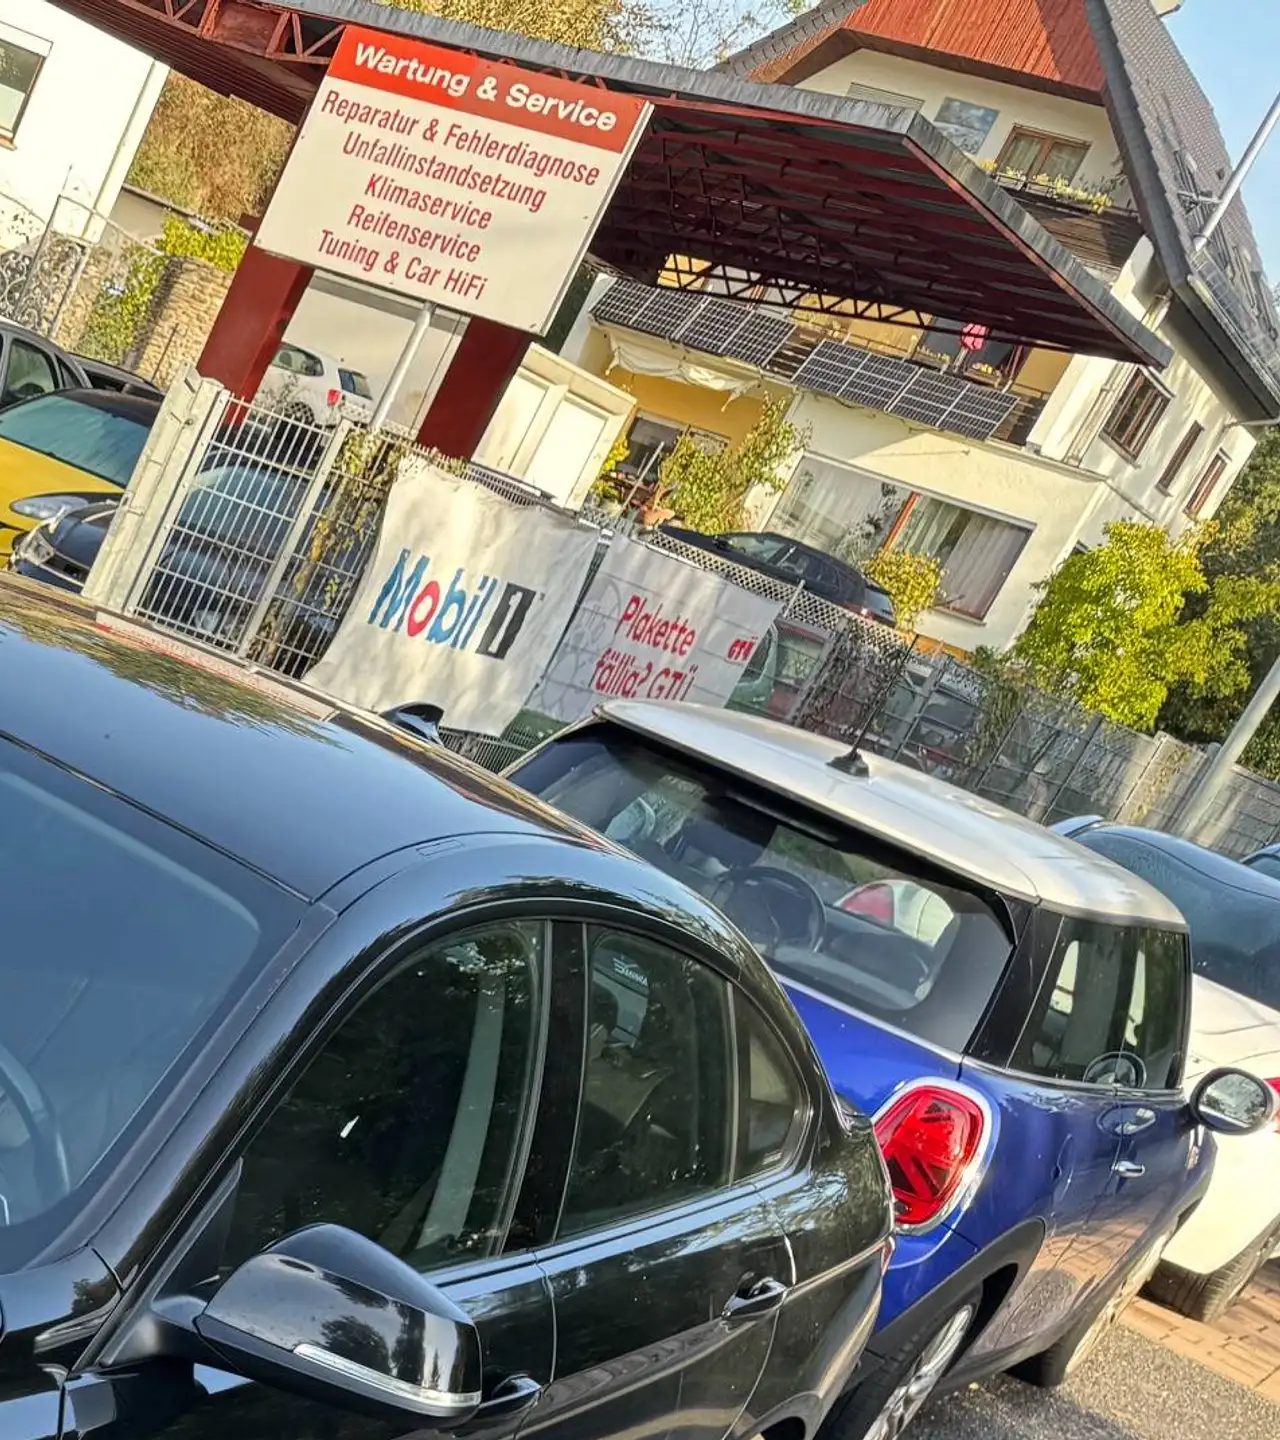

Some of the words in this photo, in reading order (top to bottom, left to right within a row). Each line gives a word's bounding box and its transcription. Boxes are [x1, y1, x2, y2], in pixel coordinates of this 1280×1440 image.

[354, 42, 472, 97] Wartung
[476, 76, 498, 102] &
[505, 83, 617, 131] Service
[321, 90, 420, 136] Reparatur
[422, 118, 440, 143] &
[443, 123, 600, 186] Fehlerdiagnose
[342, 131, 547, 213] Unfallinstandsetzung
[346, 203, 482, 263] Reifenservice
[364, 173, 493, 230] Klimaservice
[317, 229, 380, 273] Tuning
[383, 250, 401, 275] &
[404, 256, 441, 287] Car
[443, 268, 489, 301] HiFi
[368, 548, 498, 650] Mobil
[485, 589, 526, 656] 1
[614, 594, 697, 657] Plakette
[647, 663, 700, 701] GTÜ
